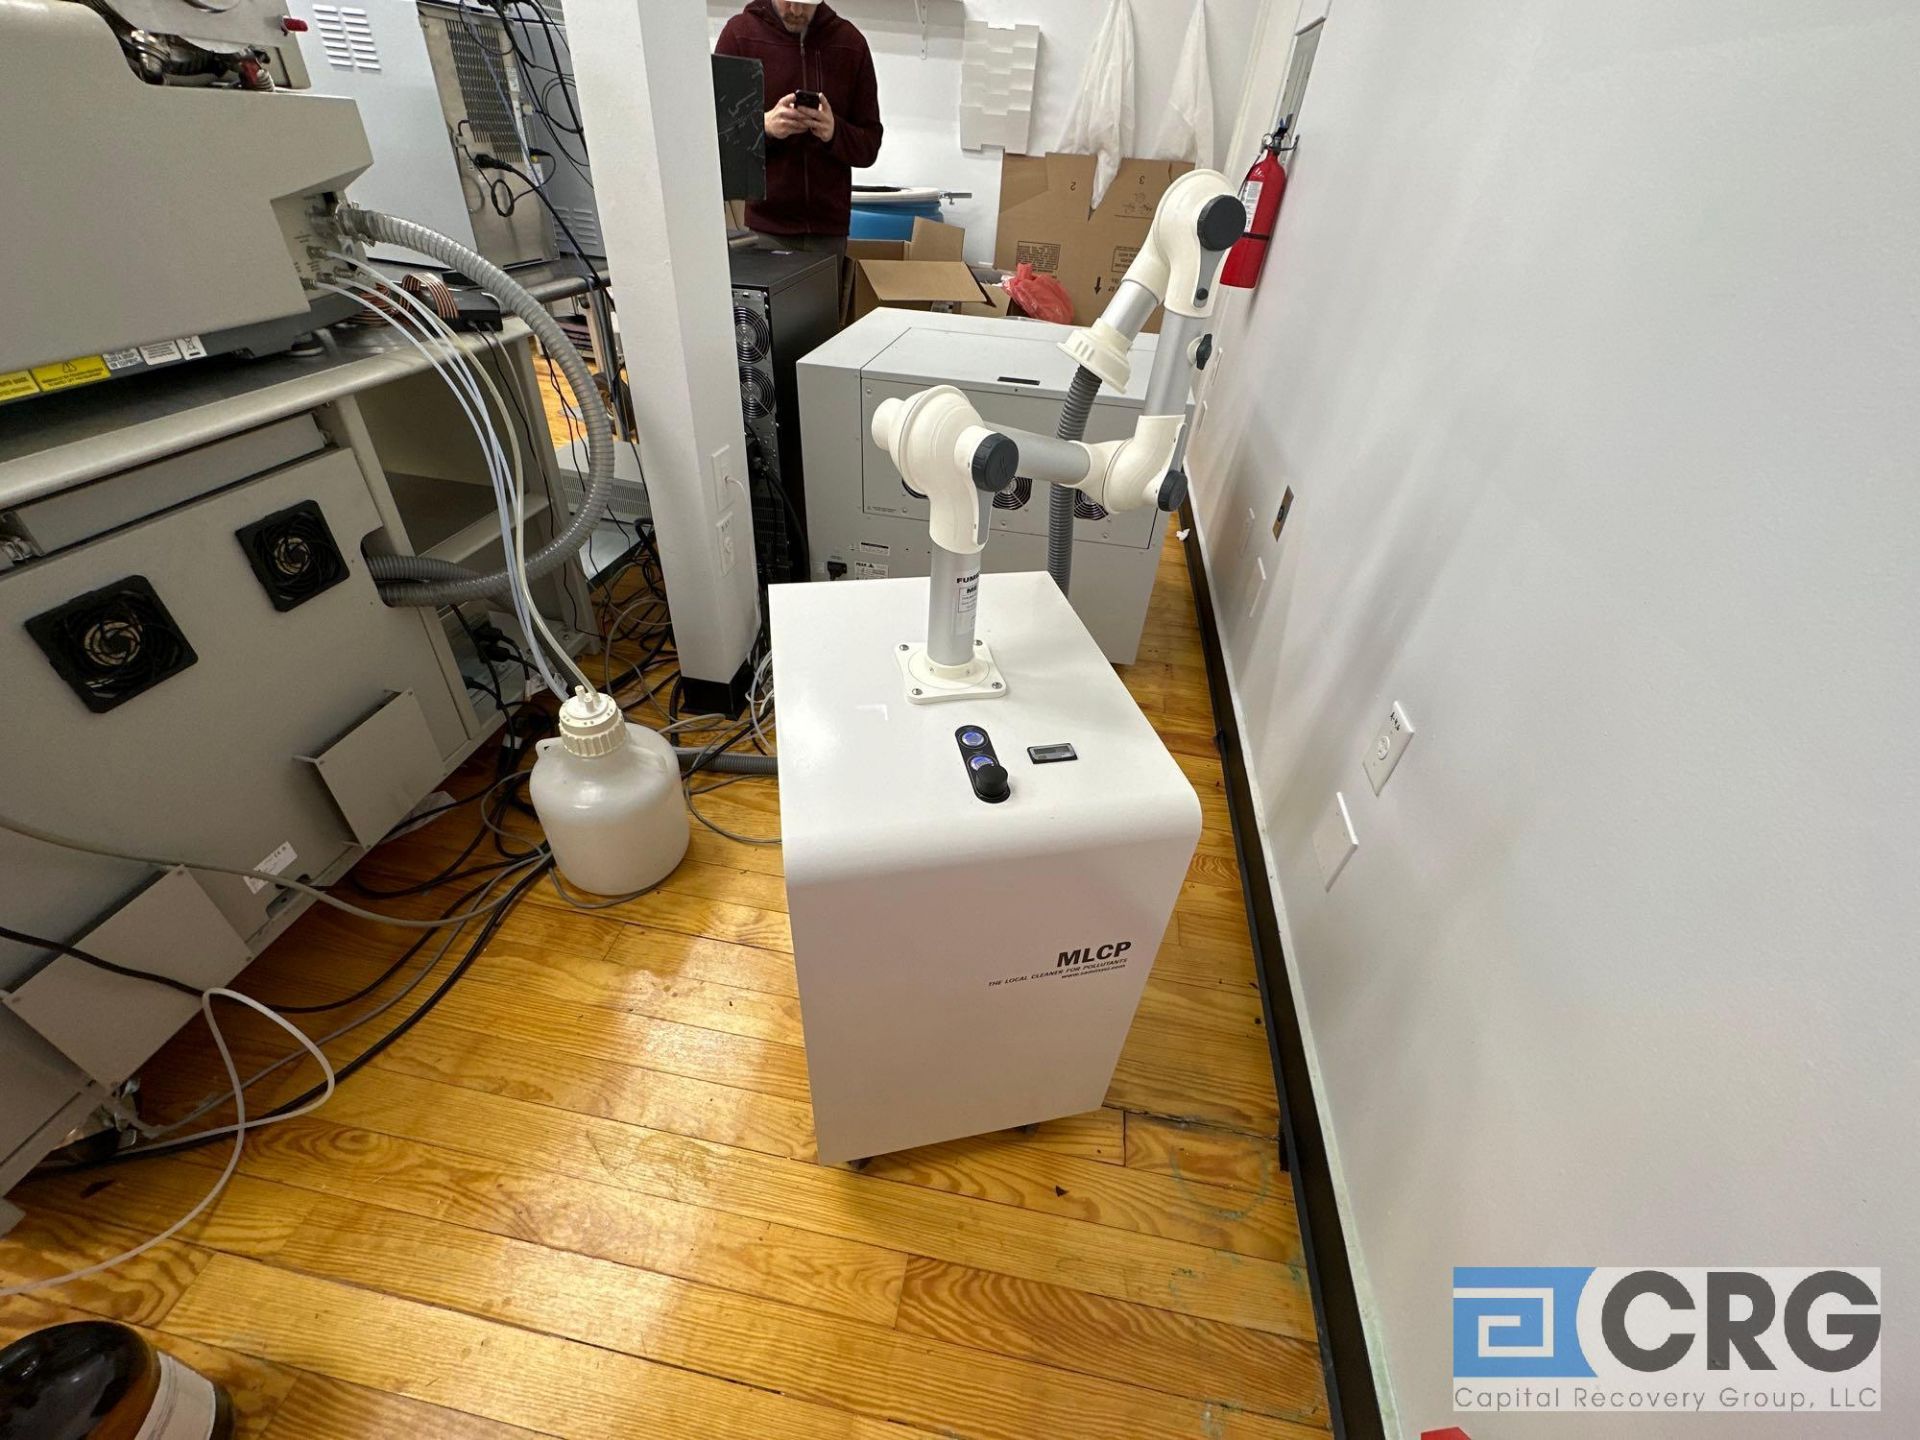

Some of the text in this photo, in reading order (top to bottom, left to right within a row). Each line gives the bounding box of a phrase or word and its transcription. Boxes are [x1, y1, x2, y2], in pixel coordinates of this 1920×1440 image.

[1070, 181, 1077, 191] 2
[1138, 175, 1145, 185] 3
[1057, 941, 1132, 968] MLCP
[988, 979, 1002, 987] THE
[1005, 975, 1027, 984] LOCAL
[1031, 967, 1063, 979] CLEANER
[1083, 958, 1128, 970] POLLUTANTS
